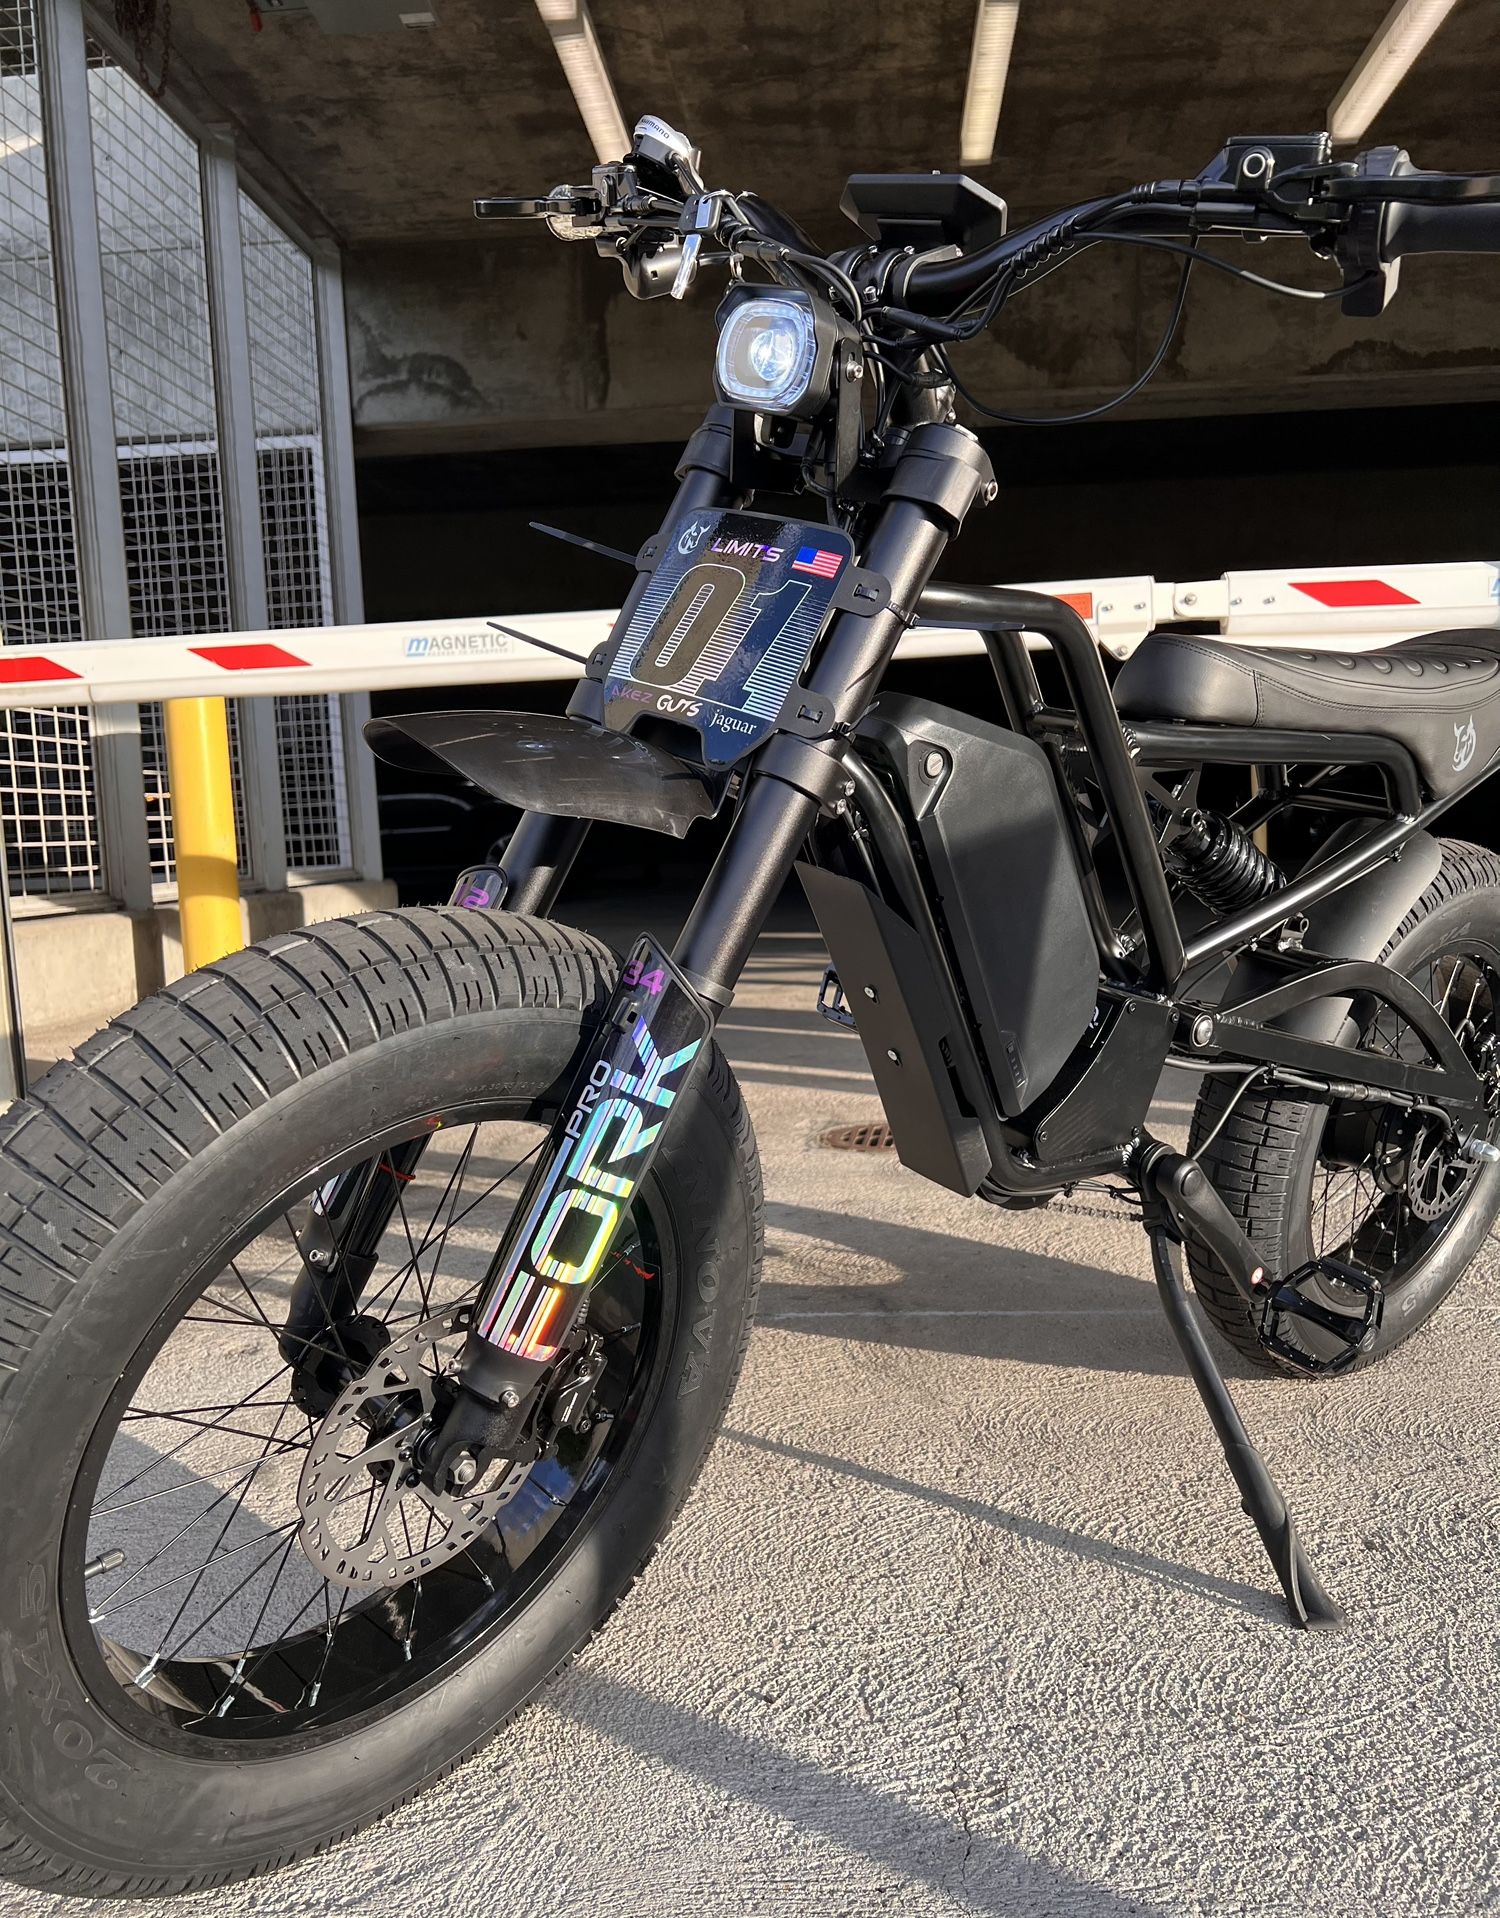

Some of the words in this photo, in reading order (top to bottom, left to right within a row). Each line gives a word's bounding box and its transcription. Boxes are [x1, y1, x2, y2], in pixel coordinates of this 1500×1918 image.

[710, 537, 786, 563] LIMITS
[656, 694, 704, 717] GUTS
[709, 709, 757, 735] jaguar
[622, 959, 665, 997] 34
[565, 1059, 613, 1139] PRO
[486, 1015, 702, 1363] FORK
